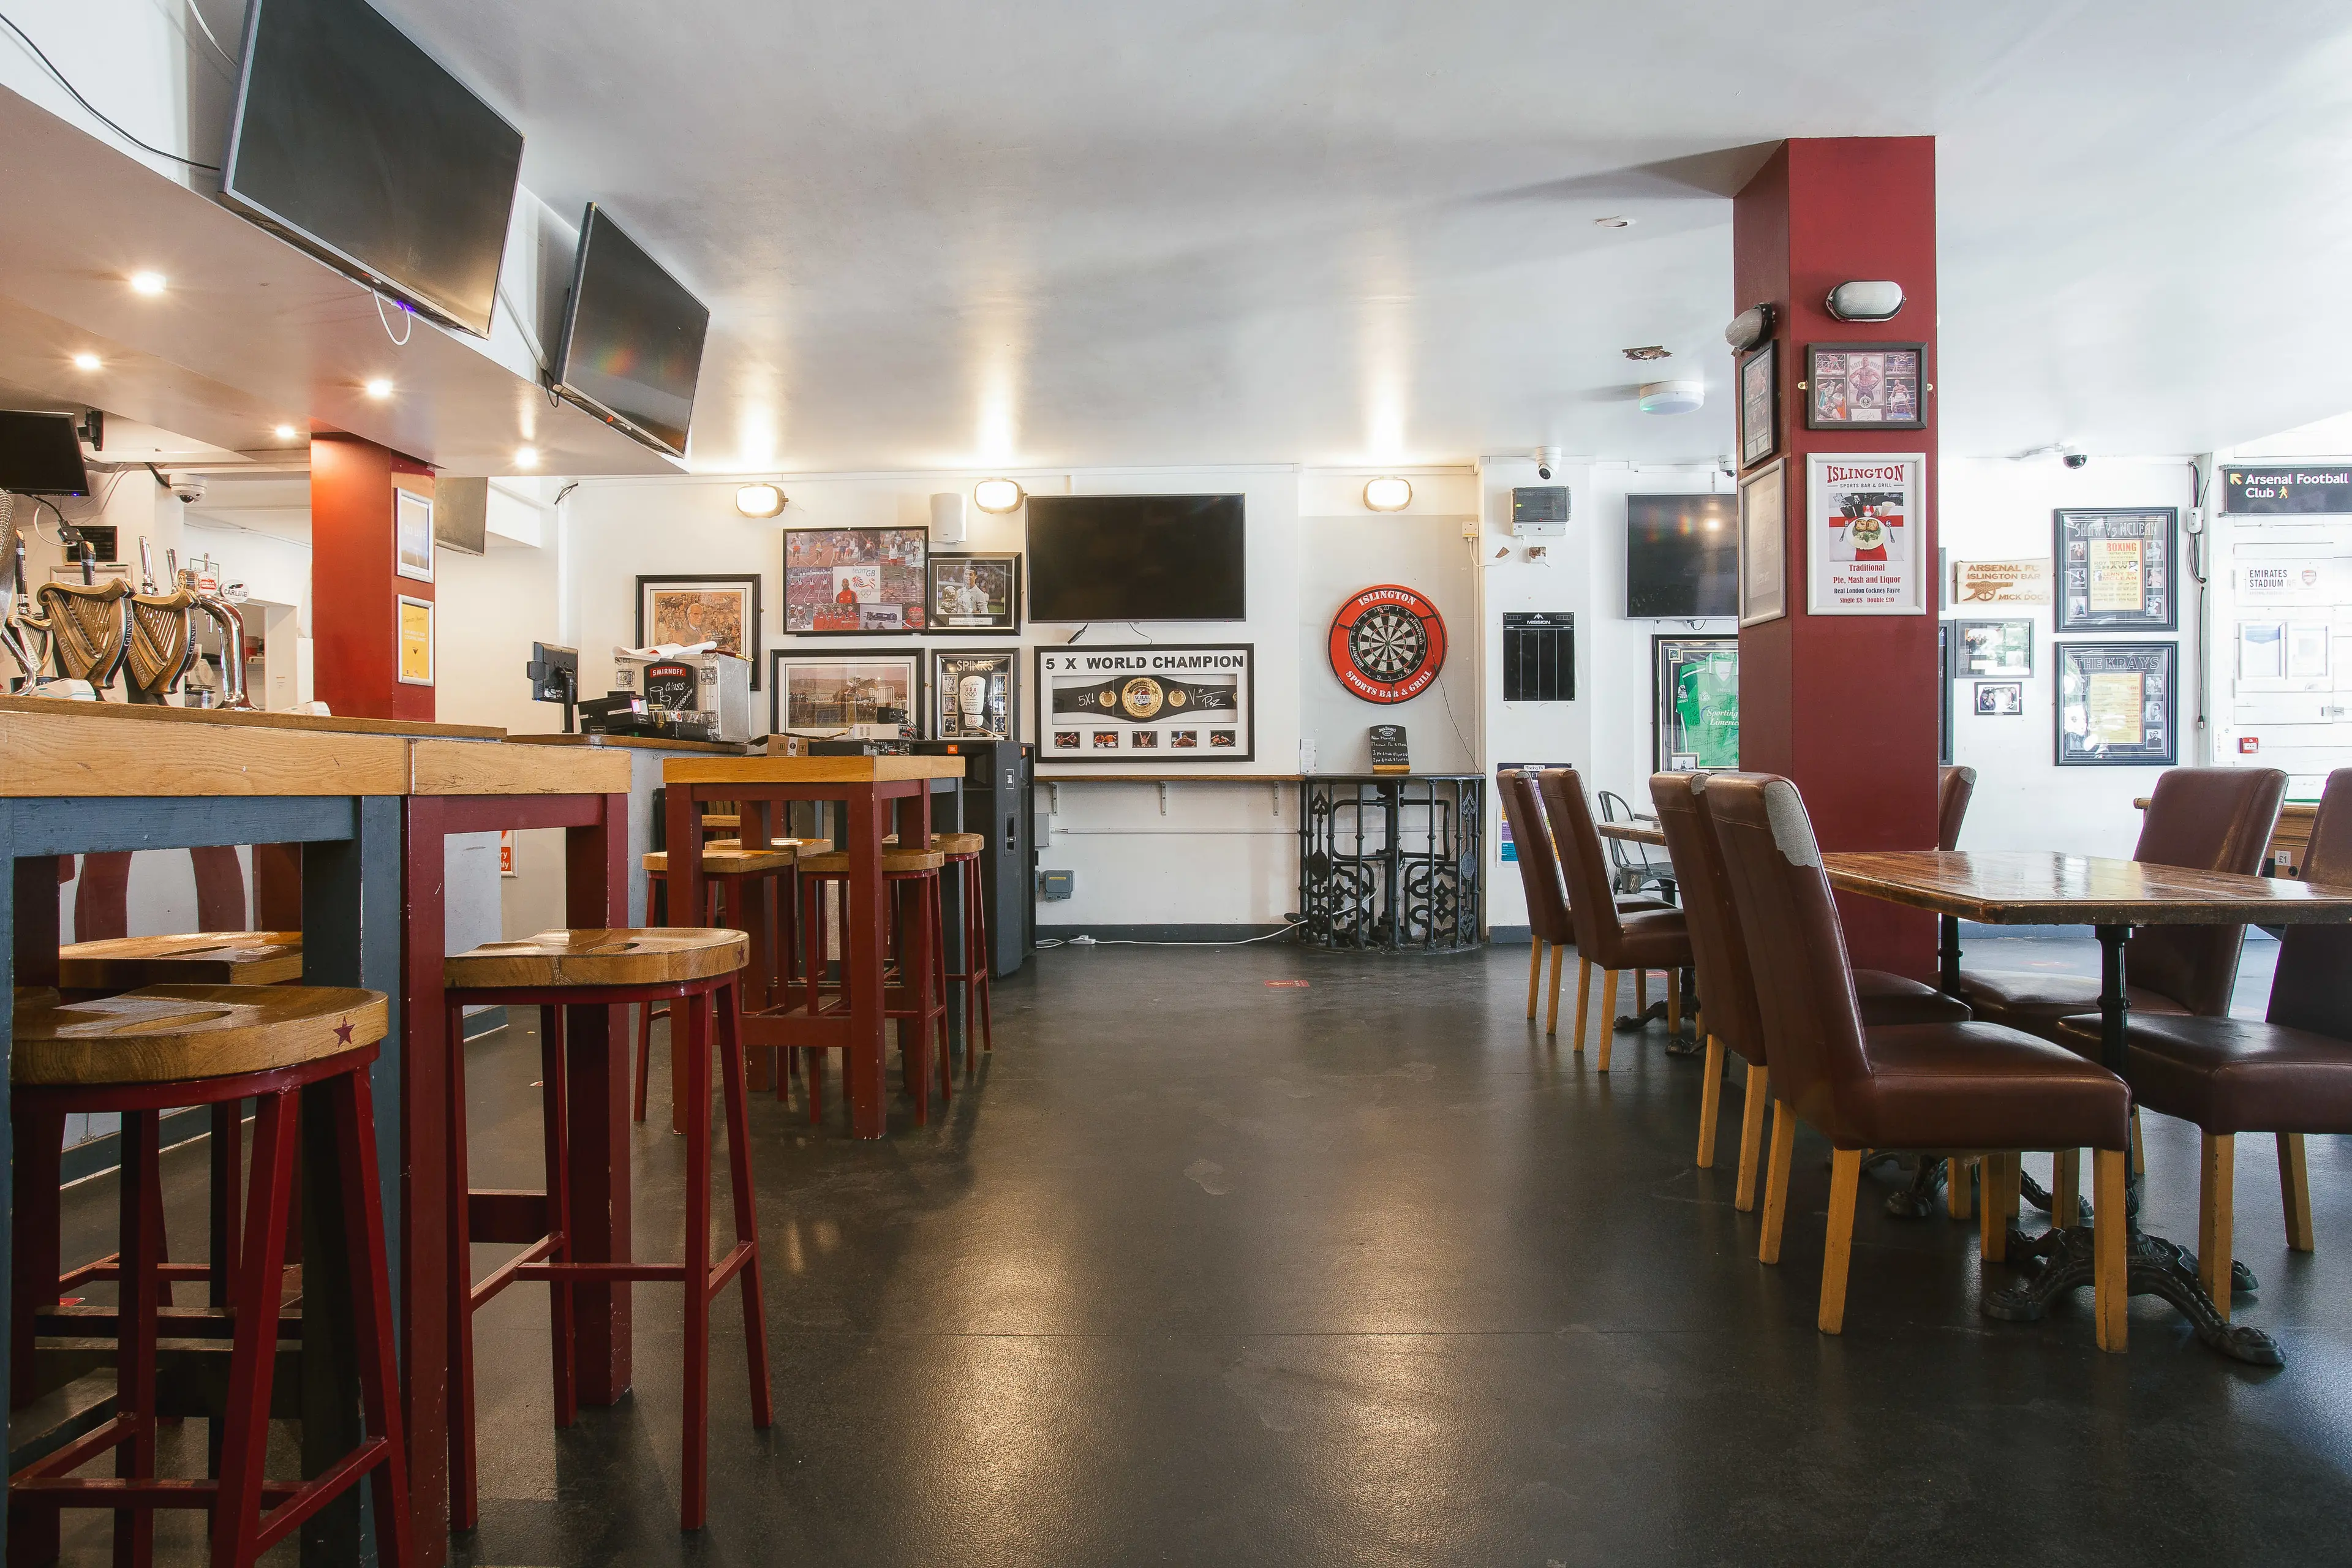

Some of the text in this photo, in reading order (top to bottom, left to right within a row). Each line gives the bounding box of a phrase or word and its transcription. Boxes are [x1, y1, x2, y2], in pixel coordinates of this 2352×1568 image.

[1827, 464, 1904, 483] ISLINGTON
[2245, 473, 2349, 484] Arsenal Football
[2245, 488, 2275, 498] Club
[405, 524, 426, 540] DJ LIVE
[2075, 523, 2101, 537] SHAW
[2119, 522, 2157, 536] MCLEAN
[2106, 542, 2137, 551] BOXING
[1880, 576, 1901, 584] Liquor
[224, 589, 247, 597] CARLING
[1357, 590, 1417, 606] ISLINGTON
[124, 609, 132, 647] GUINNESS
[187, 619, 196, 655] GUINNESS
[59, 636, 82, 677] GUINNESS
[1046, 655, 1244, 670] 5 X WORLD CHAMPION
[2074, 657, 2160, 669] THE KRAYS
[956, 660, 994, 671] SPINKS
[665, 682, 685, 692] Glass
[1346, 670, 1378, 696] SPORTS
[1379, 688, 1399, 698] BAR
[1409, 670, 1432, 692] GRILL
[673, 688, 693, 711] OLLECTION
[1078, 692, 1095, 706] 5X!
[1706, 708, 1738, 718] Sporting
[2278, 855, 2286, 864] £1
